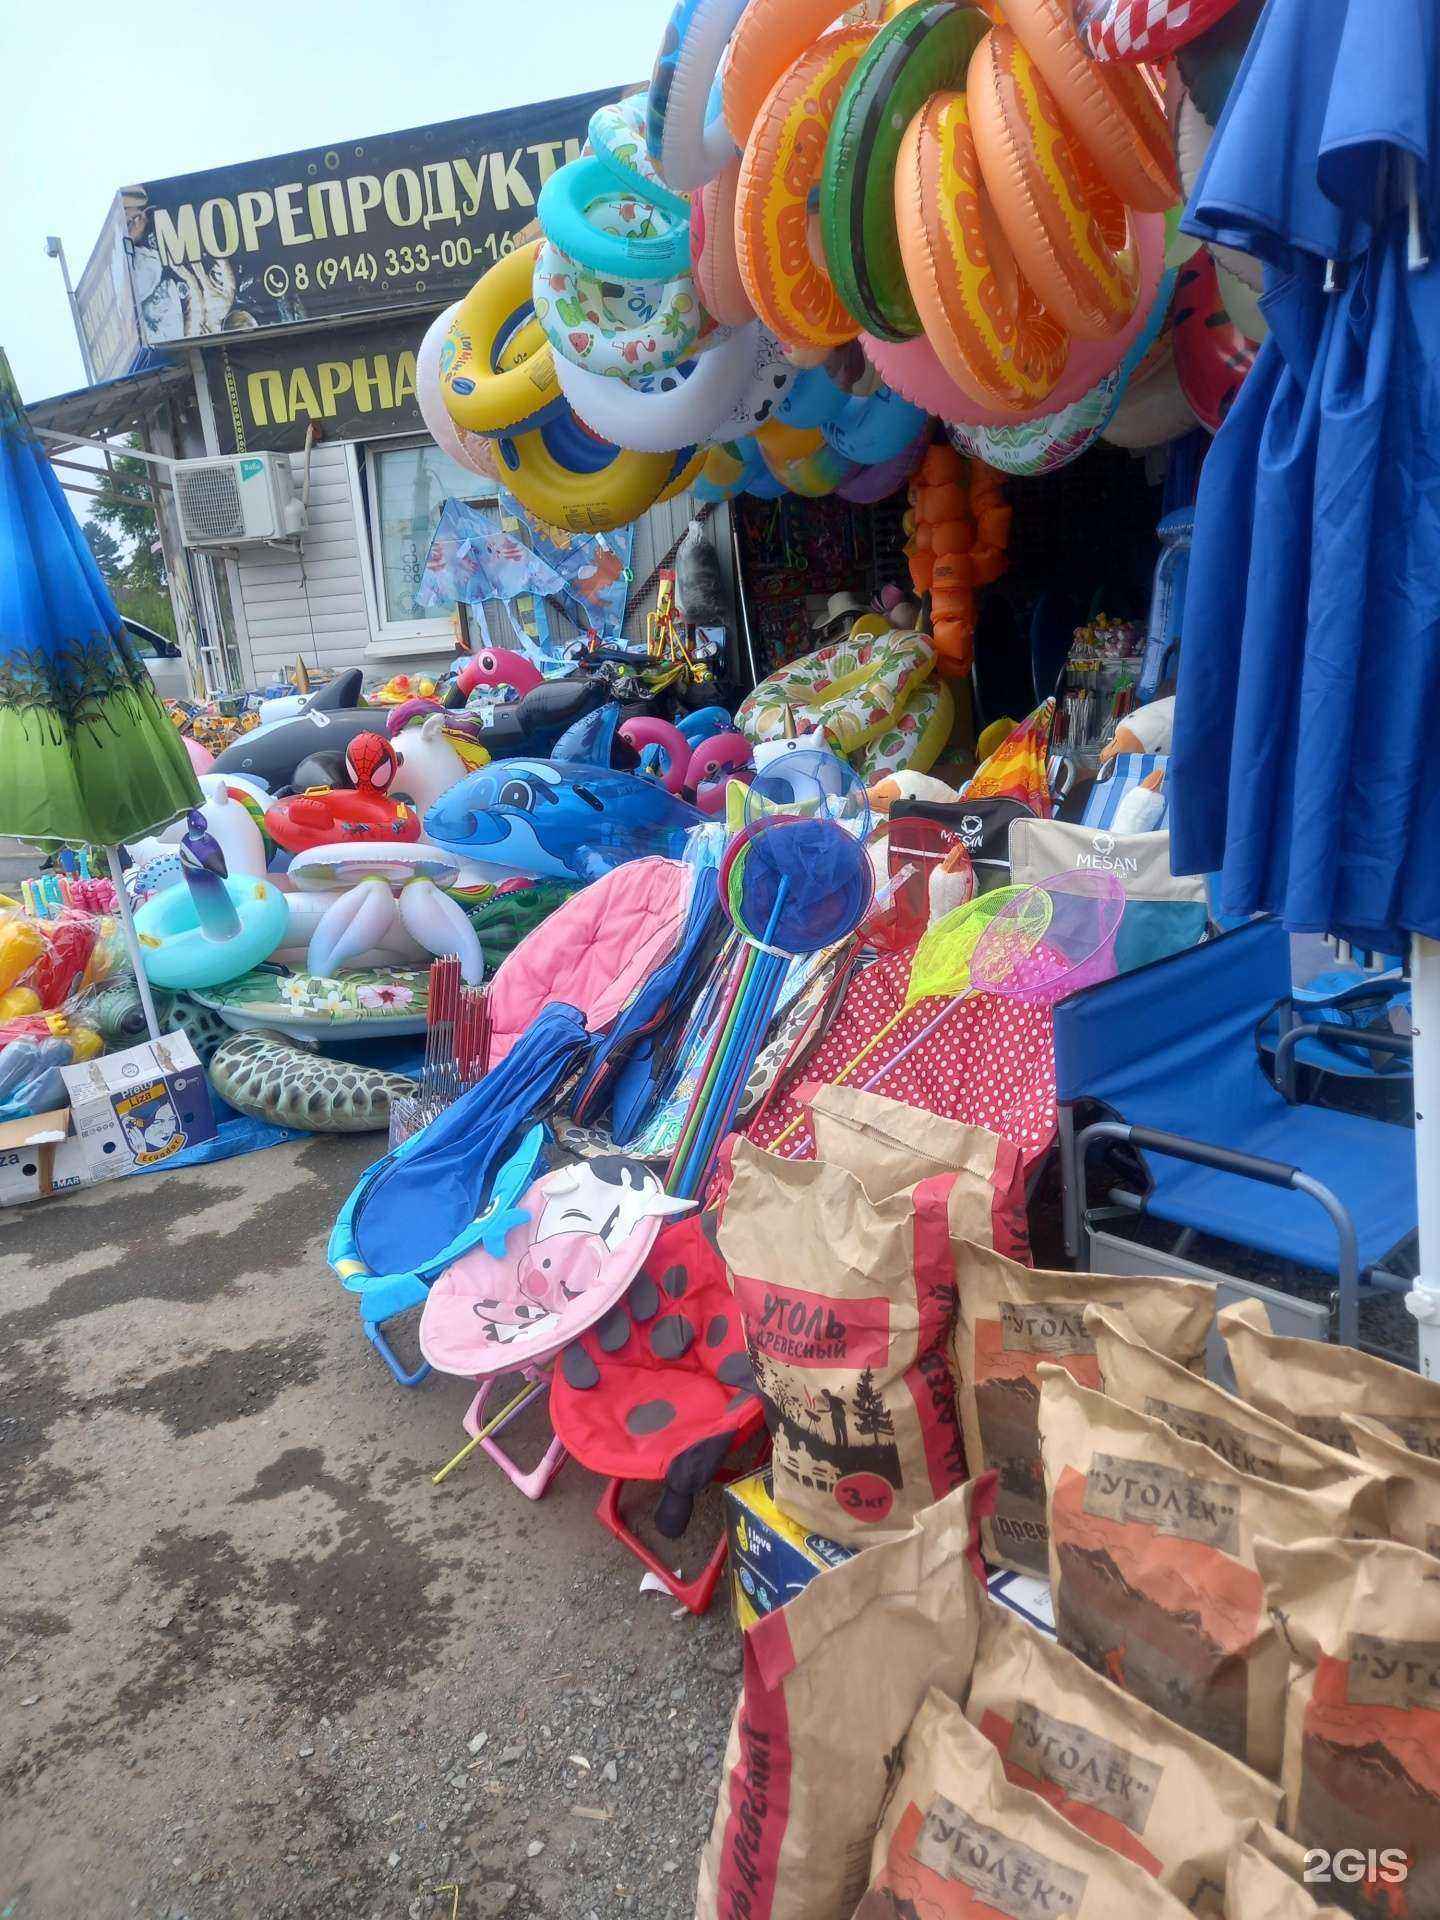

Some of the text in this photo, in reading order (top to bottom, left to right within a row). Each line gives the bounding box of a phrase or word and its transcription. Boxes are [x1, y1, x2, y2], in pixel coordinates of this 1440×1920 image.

[294, 263, 309, 290] 8
[315, 250, 378, 290] (914)
[1076, 853, 1138, 872] MESAN
[122, 1081, 154, 1099] Pretty
[129, 1091, 152, 1108] Liza
[142, 1136, 181, 1161] Ecuador
[759, 1292, 847, 1342] УГОЛЬ
[753, 1533, 771, 1553] love
